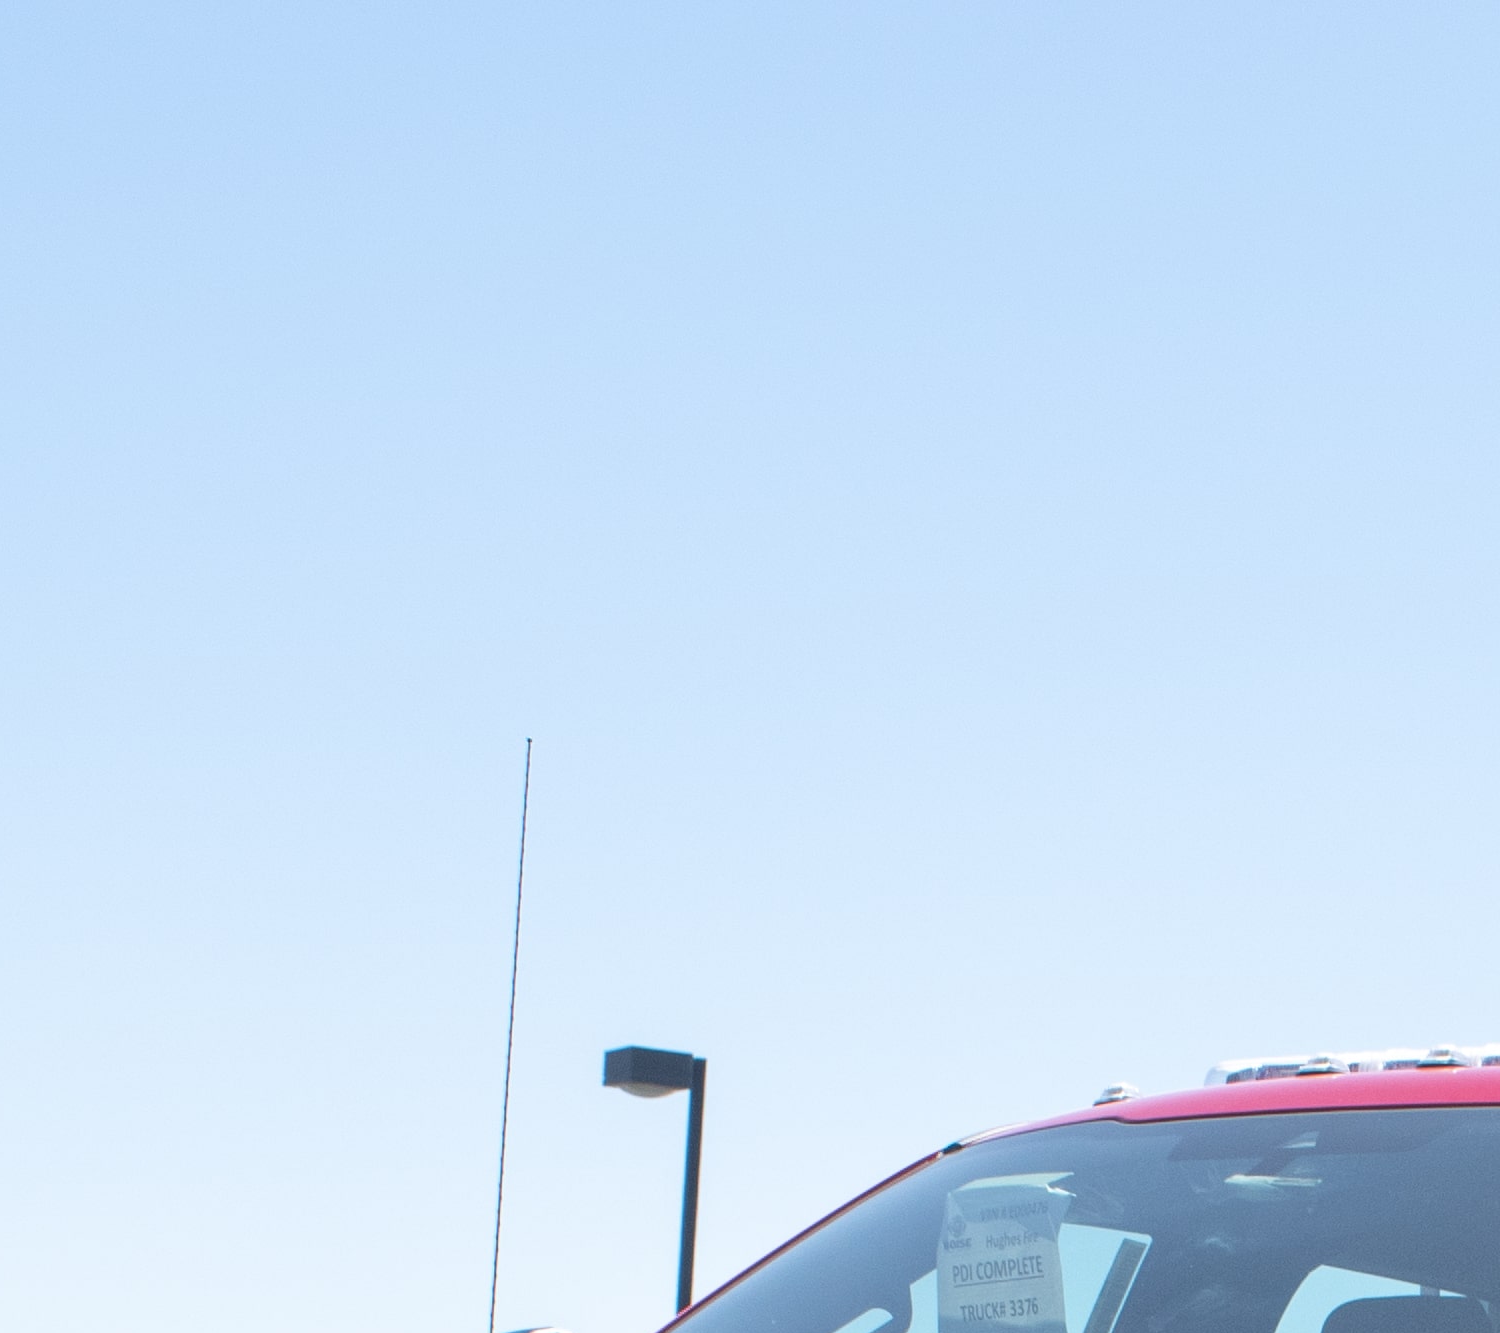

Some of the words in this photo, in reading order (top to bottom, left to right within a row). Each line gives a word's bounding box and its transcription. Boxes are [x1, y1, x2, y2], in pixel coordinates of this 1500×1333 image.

[986, 1230, 1021, 1249] Hughes
[952, 1263, 973, 1284] PDI
[976, 1255, 1043, 1280] COMPLETE
[960, 1301, 1006, 1322] TRUCK#
[1010, 1297, 1039, 1317] 3376
